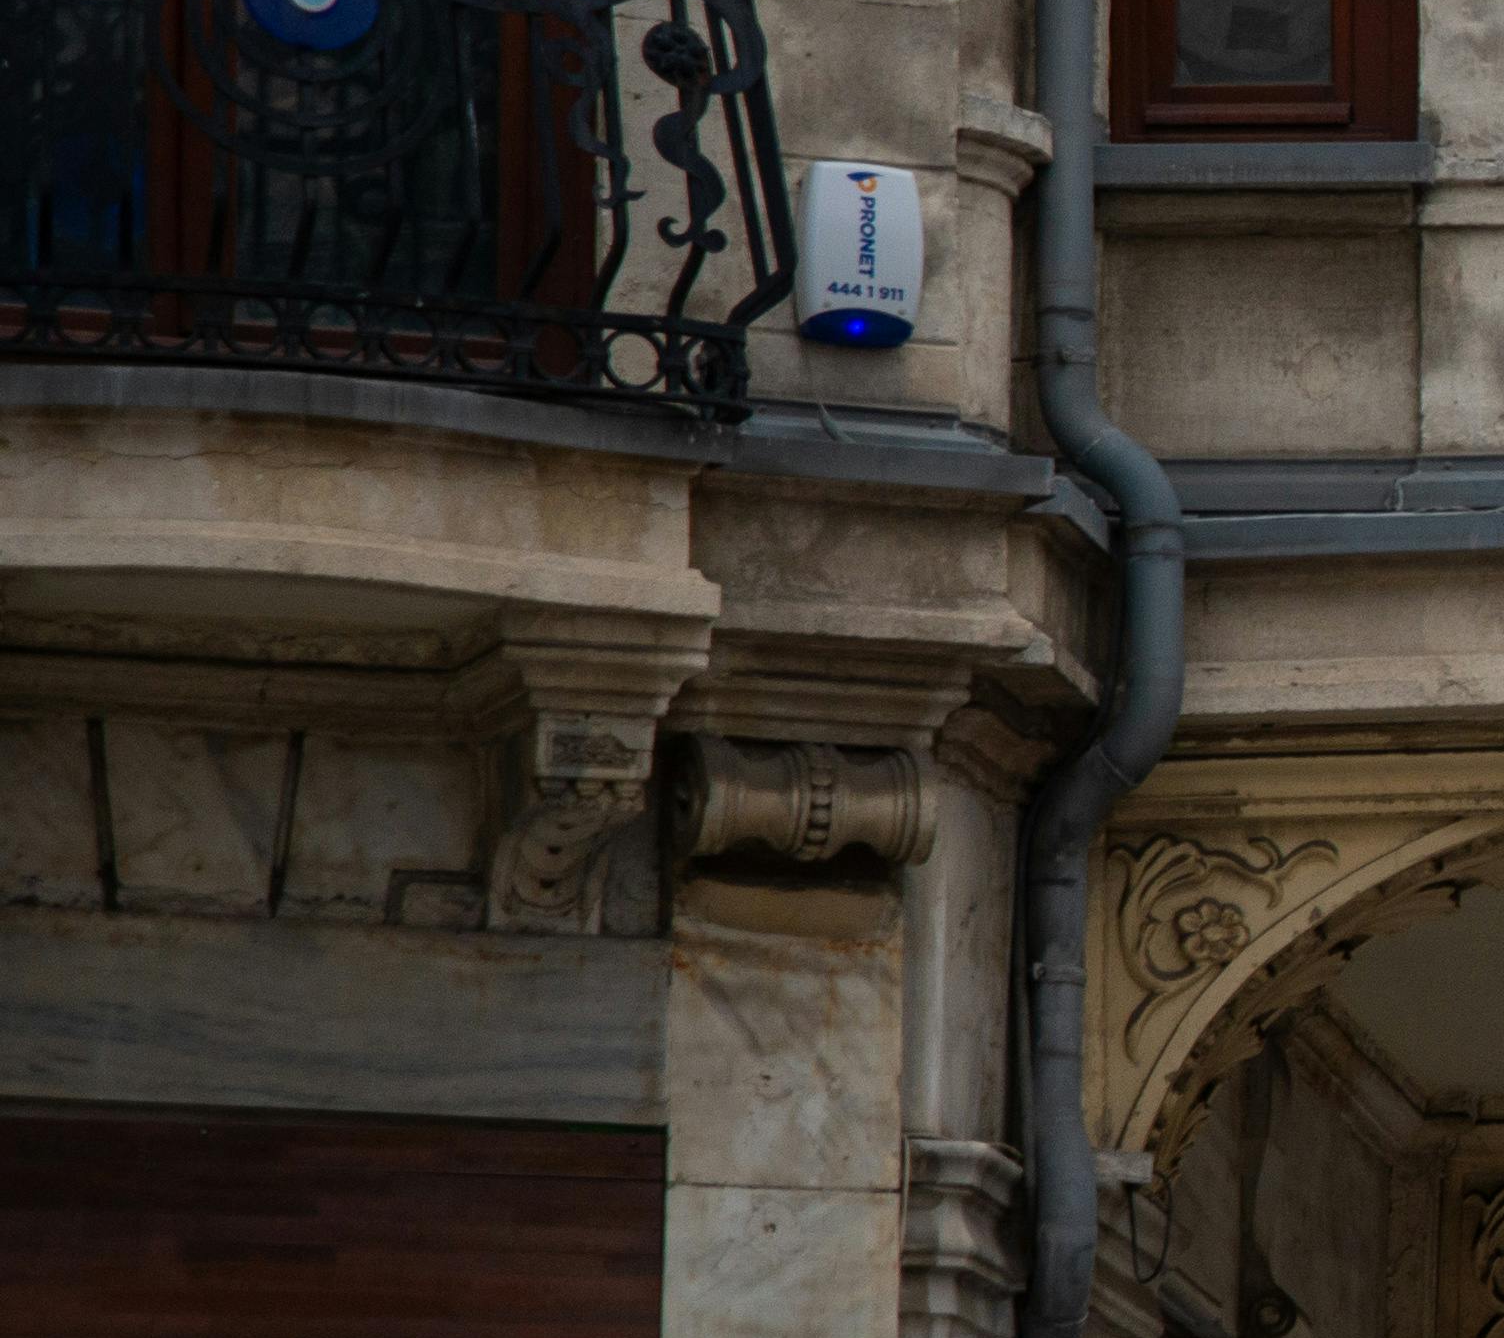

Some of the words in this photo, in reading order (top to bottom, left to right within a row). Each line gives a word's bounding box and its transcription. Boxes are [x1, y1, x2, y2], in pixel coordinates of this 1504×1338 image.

[859, 196, 876, 278] PRONET
[828, 281, 862, 296] 444
[866, 286, 874, 298] 1
[879, 287, 904, 301] 911
